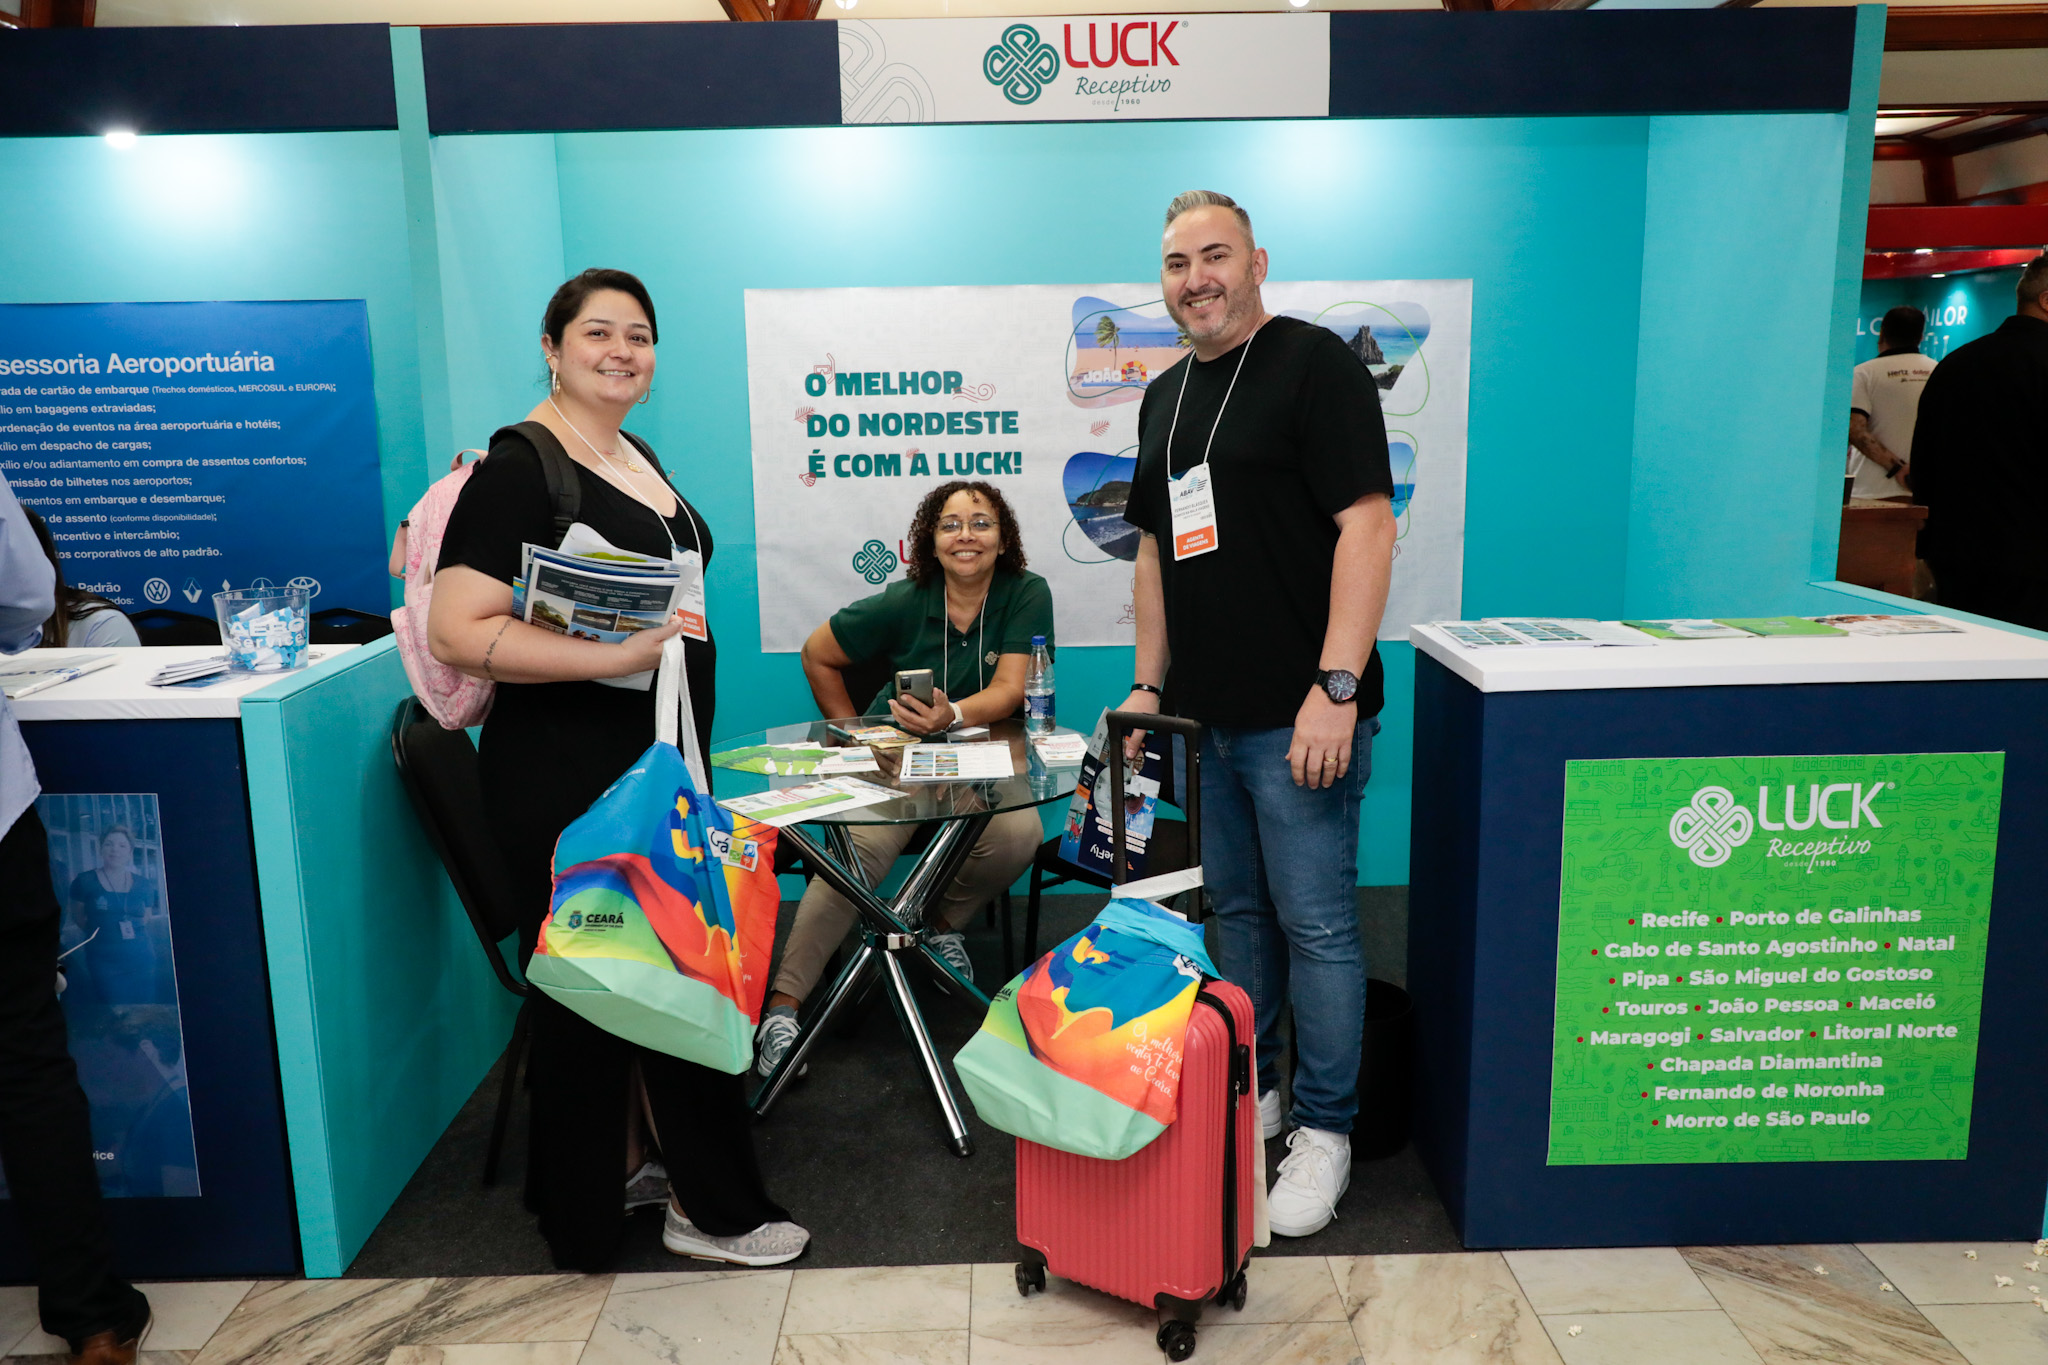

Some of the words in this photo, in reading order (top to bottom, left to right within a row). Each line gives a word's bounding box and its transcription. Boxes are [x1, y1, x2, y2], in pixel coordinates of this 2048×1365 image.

[1064, 21, 1180, 68] LUCK
[1075, 73, 1171, 111] Receptivo
[1092, 98, 1115, 106] desde
[107, 350, 275, 378] Aeroportuária
[805, 373, 826, 397] O
[835, 370, 963, 396] MELHOR
[1083, 367, 1121, 383] JOÃO
[24, 386, 38, 396] de
[40, 385, 76, 395] cartão
[78, 385, 92, 395] de
[95, 385, 149, 397] embarque
[152, 386, 187, 396] (Trechos
[188, 384, 237, 394] domésticos,
[238, 383, 287, 393] MERCOSUL
[16, 406, 33, 414] em
[35, 404, 88, 416] bagagens
[91, 403, 156, 414] extraviadas;
[56, 423, 70, 432] de
[73, 423, 115, 432] eventos
[118, 423, 131, 431] na
[134, 421, 158, 431] área
[160, 420, 233, 432] aeroportuária
[236, 421, 242, 429] e
[245, 419, 281, 430] hotéis;
[807, 413, 850, 437] DO
[858, 411, 1019, 437] NORDESTE
[40, 441, 93, 452] despacho
[95, 441, 109, 450] de
[112, 441, 152, 451] cargas;
[23, 459, 47, 469] e/ou
[49, 459, 121, 469] adiantamento
[123, 460, 140, 468] em
[142, 459, 183, 469] compra
[186, 458, 200, 467] de
[202, 457, 250, 467] assentos
[253, 456, 307, 467] confortos;
[808, 449, 826, 478] É
[834, 453, 901, 478] COM
[909, 453, 930, 476] A
[938, 451, 1022, 476] LUCK!
[50, 477, 64, 487] de
[66, 477, 109, 487] bilhetes
[111, 478, 131, 487] nos
[133, 476, 193, 488] aeroportos;
[65, 496, 81, 505] em
[84, 495, 138, 507] embarque
[140, 496, 147, 504] e
[150, 493, 226, 506] desembarque;
[49, 513, 62, 523] de
[65, 513, 107, 523] assento
[110, 514, 150, 524] (conforme
[152, 513, 217, 523] disponibilidade);
[53, 531, 102, 541] incentivo
[104, 532, 111, 540] e
[114, 530, 180, 541] intercâmbio;
[74, 548, 141, 560] corporativos
[144, 548, 157, 558] de
[160, 548, 180, 557] alto
[183, 547, 223, 559] padrão.
[77, 582, 121, 593] Padrão
[1758, 782, 1885, 831] LUCK
[1767, 835, 1871, 873] Receptivo
[586, 912, 624, 924] CEARÁ
[1642, 911, 1710, 929] Recife
[1730, 909, 1789, 928] Porto
[1795, 908, 1822, 925] de
[1828, 906, 1922, 925] Galinhas
[1604, 942, 1660, 958] Cabo
[1665, 940, 1692, 957] de
[1697, 939, 1760, 957] Santo
[1765, 936, 1878, 958] Agostinho
[1898, 935, 1955, 952] Natal
[1622, 972, 1669, 990] Pipa
[1689, 970, 1729, 987] São
[1735, 967, 1807, 988] Miguel
[1813, 967, 1840, 983] do
[1846, 966, 1933, 983] Gostoso
[1616, 1001, 1688, 1017] Touros
[1706, 997, 1758, 1016] João
[1764, 996, 1840, 1014] Pessoa
[1859, 993, 1936, 1011] Maceió
[1590, 1027, 1691, 1048] Maragogi
[1709, 1026, 1804, 1043] Salvador
[1822, 1023, 1892, 1041] Litoral
[1898, 1022, 1958, 1039] Norte
[1130, 1064, 1143, 1075] ao
[1660, 1056, 1754, 1074] Chapada
[1759, 1053, 1883, 1071] Diamantina
[1655, 1084, 1756, 1101] Fernando
[1761, 1084, 1788, 1100] de
[1794, 1081, 1885, 1098] Noronha
[1665, 1112, 1728, 1129] Morro
[1733, 1111, 1760, 1128] de
[1766, 1109, 1805, 1127] São
[1810, 1109, 1871, 1126] Paulo
